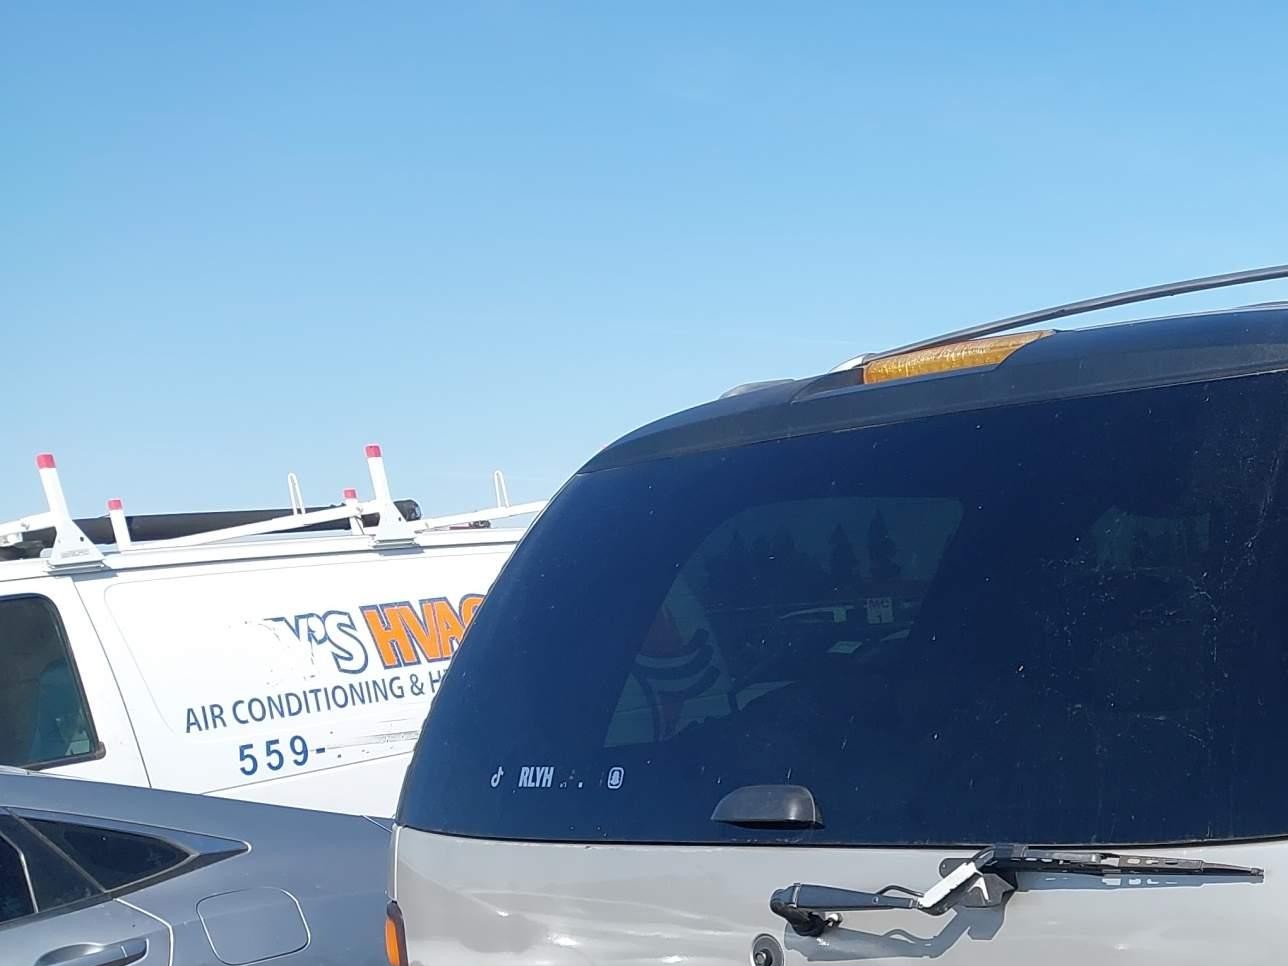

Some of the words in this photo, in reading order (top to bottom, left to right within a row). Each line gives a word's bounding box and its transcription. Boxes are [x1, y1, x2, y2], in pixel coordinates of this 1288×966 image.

[185, 703, 228, 734] AIR
[231, 675, 405, 726] CONDITIONING
[409, 673, 425, 697] &
